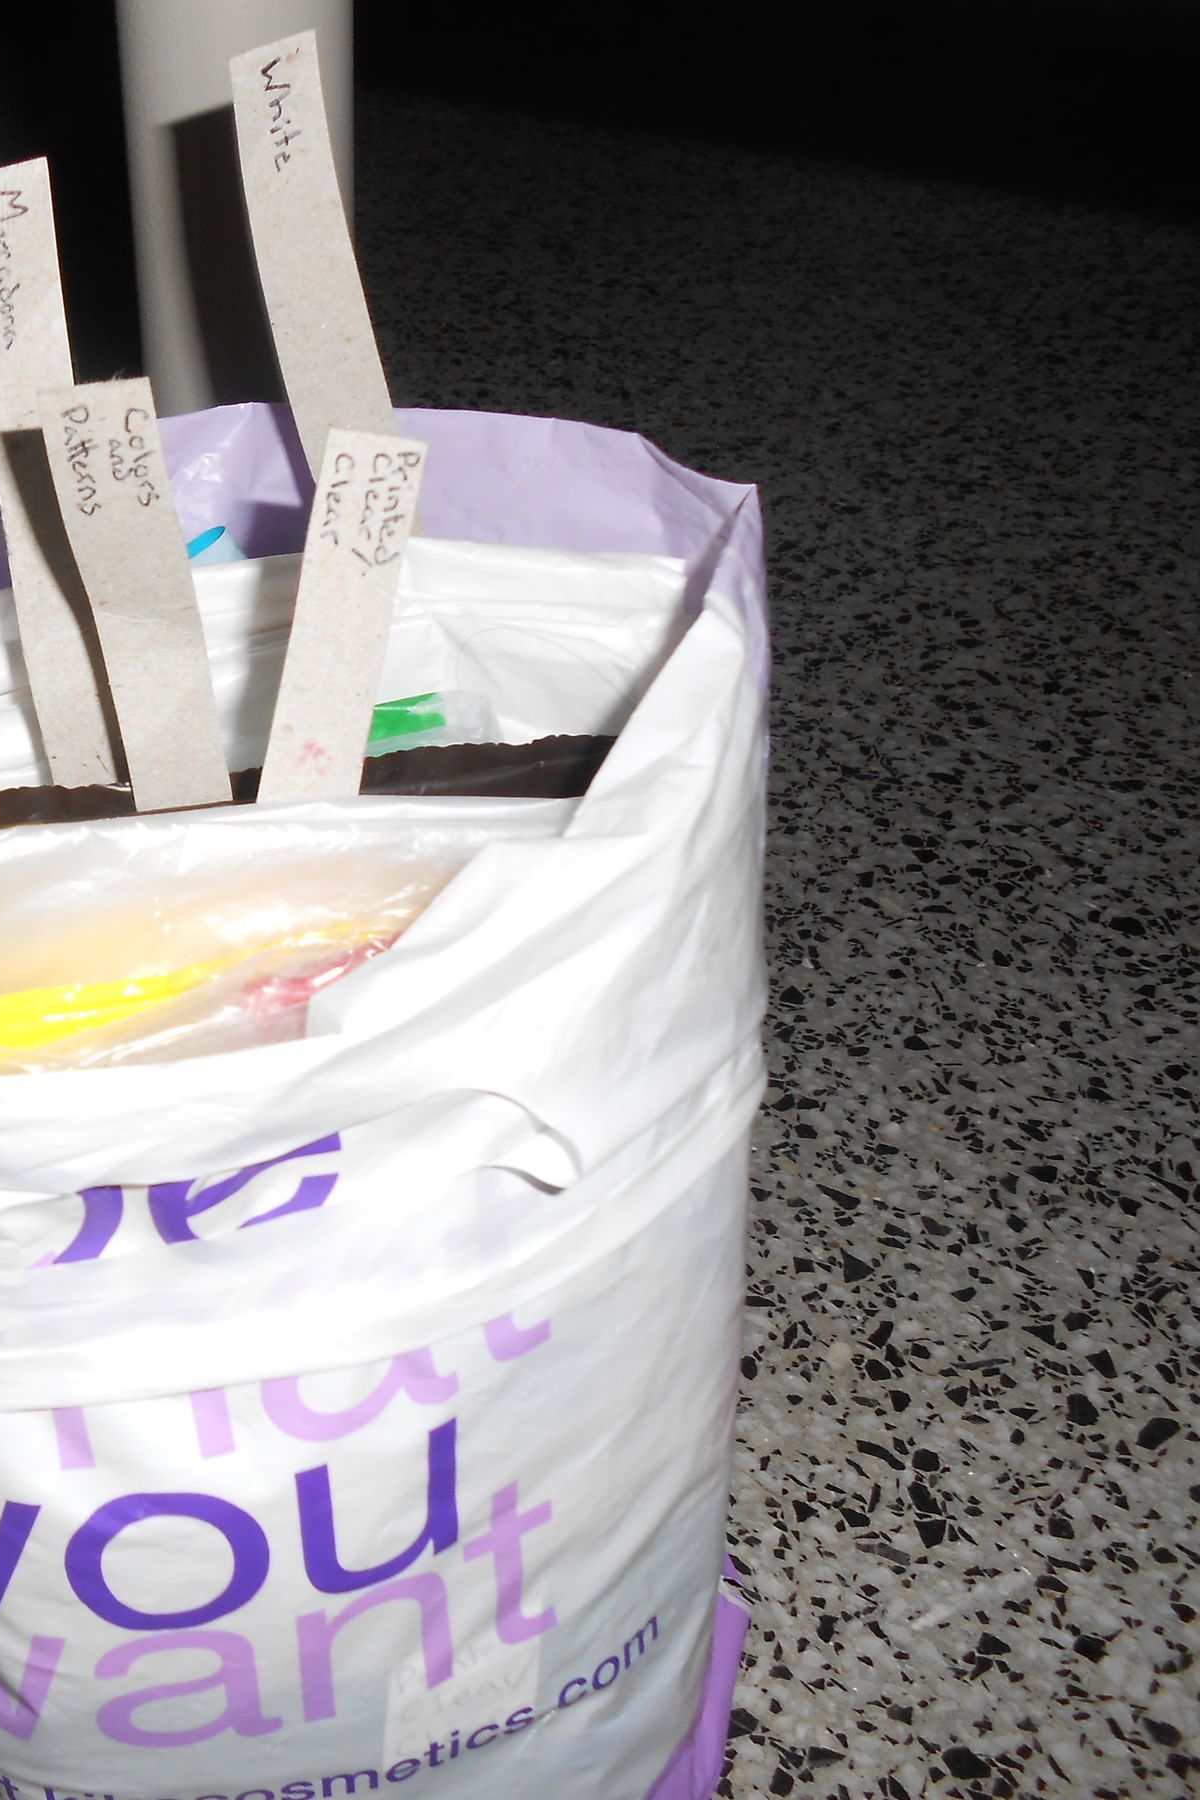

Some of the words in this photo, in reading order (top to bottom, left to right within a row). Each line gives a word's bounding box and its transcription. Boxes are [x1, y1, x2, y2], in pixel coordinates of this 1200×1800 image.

[260, 57, 301, 172] White
[61, 406, 101, 516] Patterns
[109, 439, 135, 481] and
[125, 408, 160, 507] Colors
[321, 453, 355, 545] Clear
[375, 451, 421, 567] Printed
